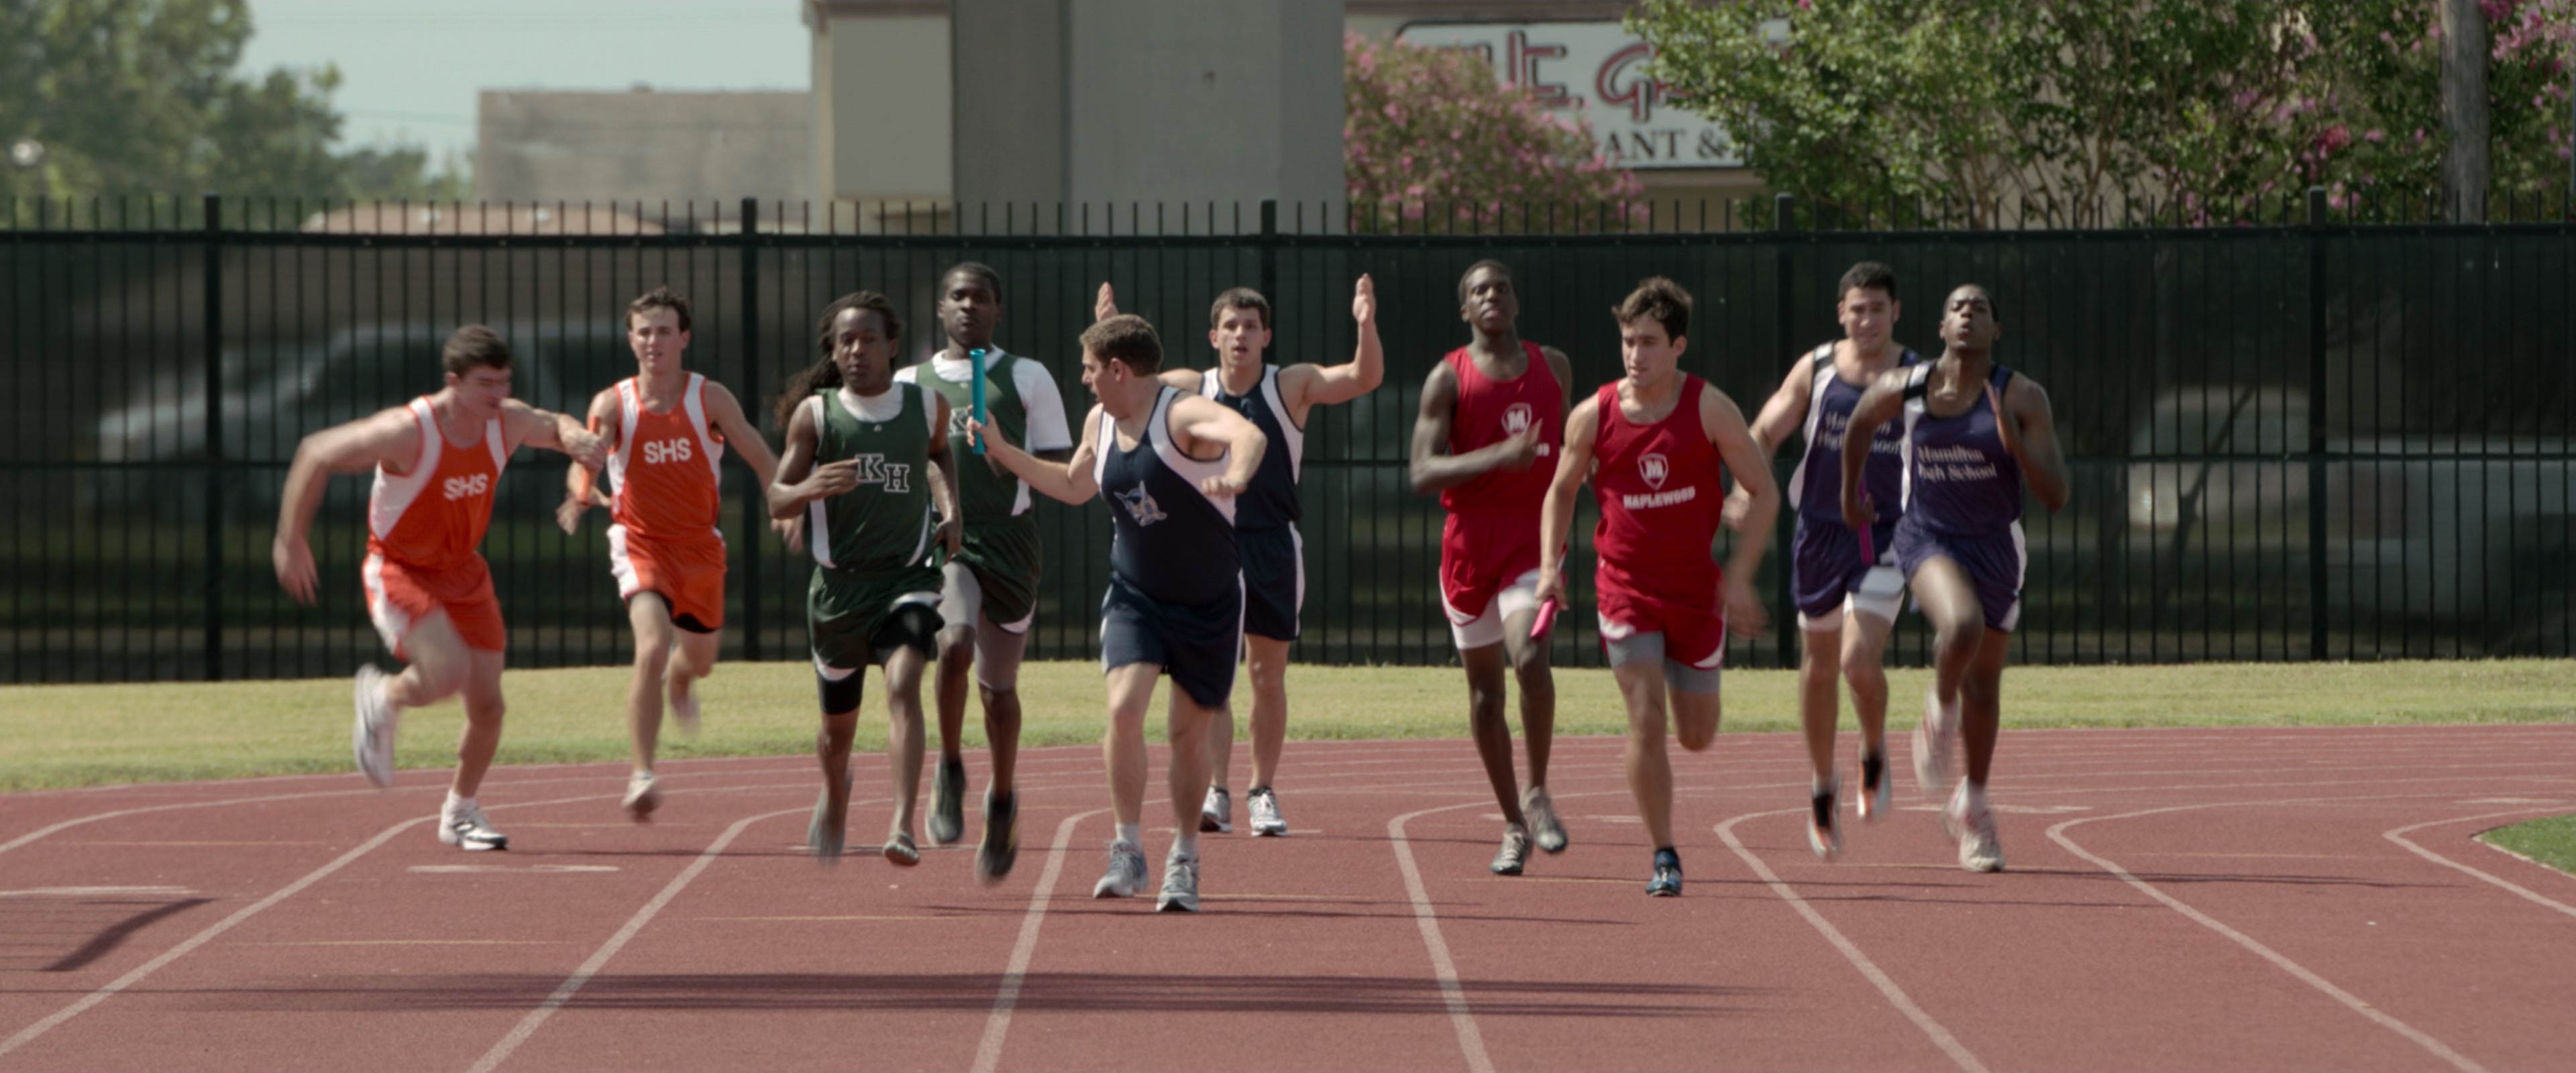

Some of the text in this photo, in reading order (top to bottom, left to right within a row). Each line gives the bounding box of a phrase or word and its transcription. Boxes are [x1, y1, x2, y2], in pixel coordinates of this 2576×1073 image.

[643, 437, 692, 464] SHS
[1917, 444, 1986, 463] Hamilton
[443, 473, 488, 501] SHS
[1623, 485, 1697, 510] MAPLEWOOD
